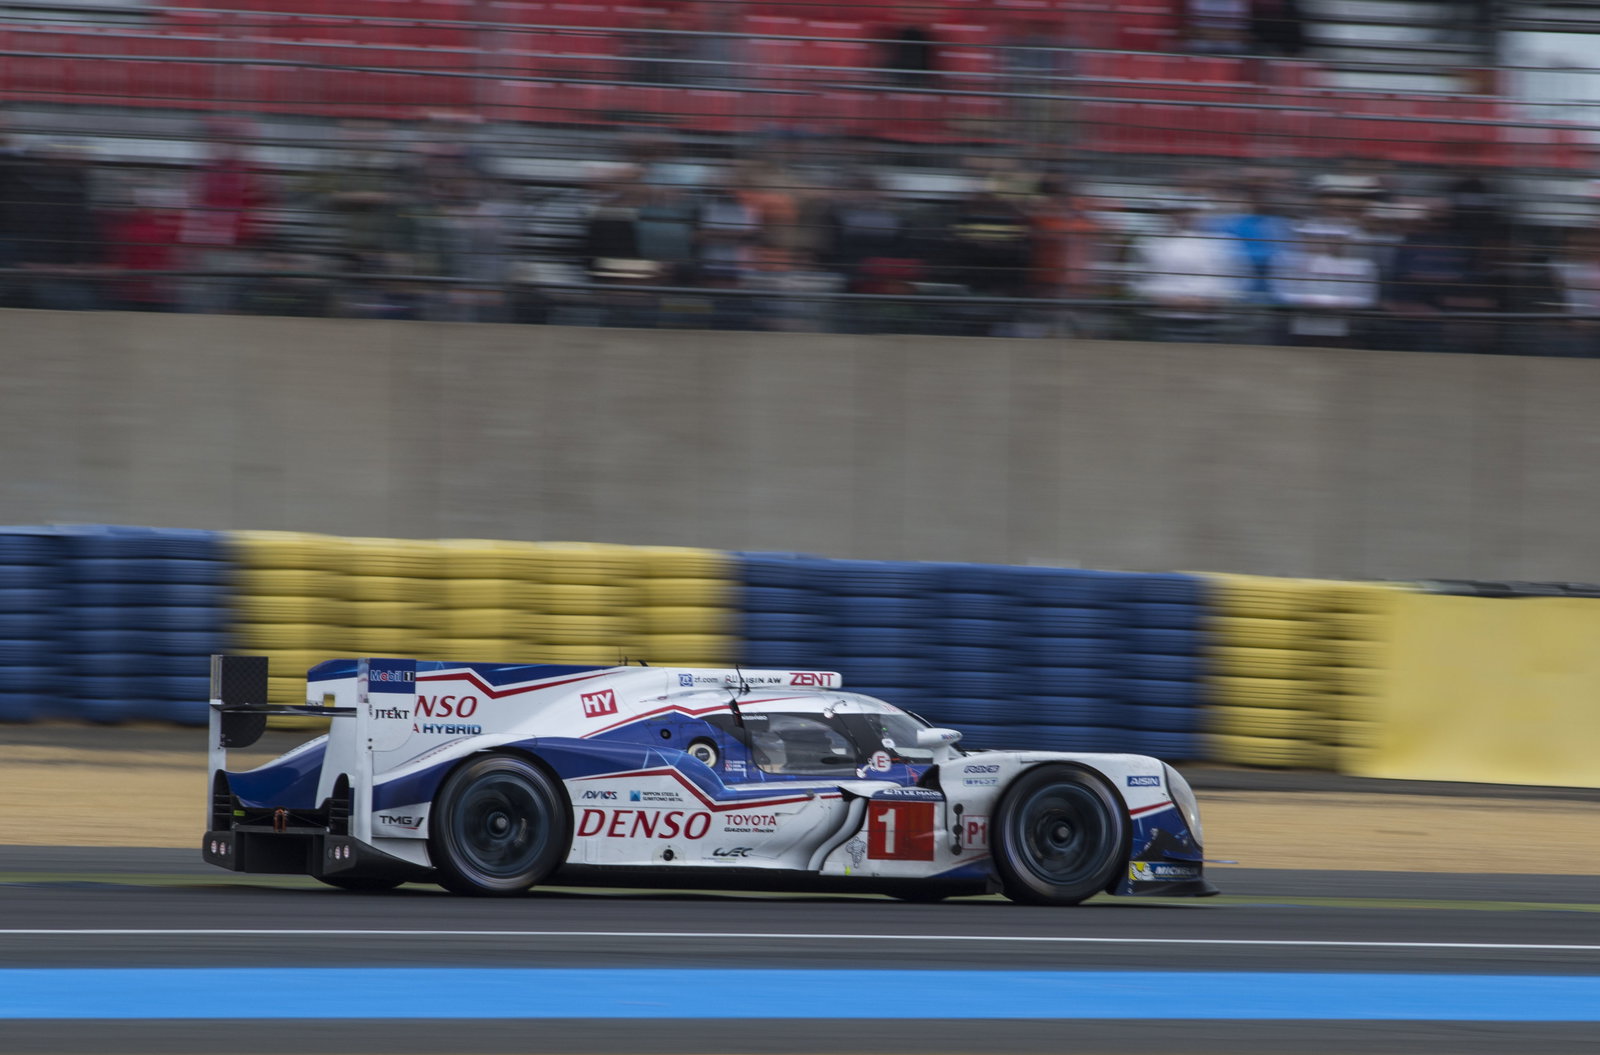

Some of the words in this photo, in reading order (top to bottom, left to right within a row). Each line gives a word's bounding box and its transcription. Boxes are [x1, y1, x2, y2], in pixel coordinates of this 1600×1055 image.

[371, 670, 401, 681] Mobil
[404, 671, 415, 682] 1
[789, 673, 834, 687] ZENT
[414, 695, 478, 718] NSO
[584, 692, 614, 714] HY
[375, 707, 410, 720] JTEKT
[423, 724, 482, 735] HYBRID
[877, 755, 887, 768] E
[1130, 777, 1159, 786] AISIN
[379, 815, 413, 825] TMG
[577, 809, 711, 840] DENSO
[725, 814, 777, 826] TOYOTA
[879, 807, 897, 854] 1
[967, 821, 987, 845] P1
